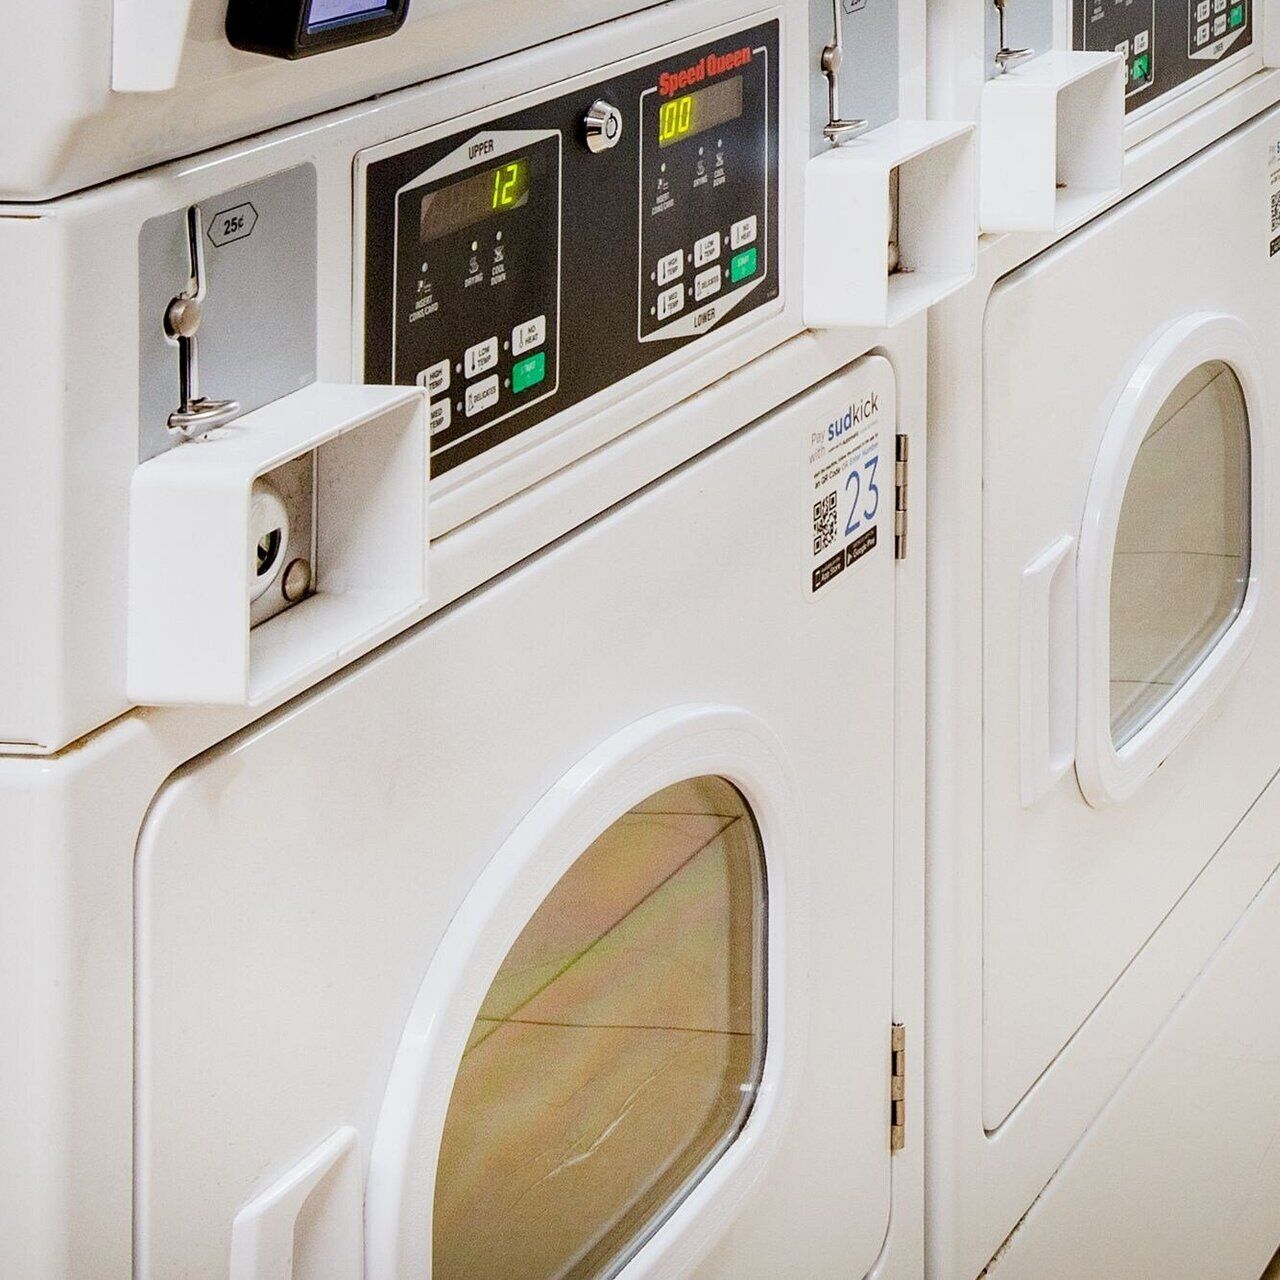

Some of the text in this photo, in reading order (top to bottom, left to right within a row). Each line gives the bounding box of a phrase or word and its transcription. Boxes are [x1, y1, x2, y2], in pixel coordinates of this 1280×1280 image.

[659, 46, 751, 96] Speed Queen
[468, 137, 494, 160] UPPER
[491, 162, 518, 210] 12
[223, 214, 244, 236] 25¢
[491, 262, 505, 276] COOL
[693, 306, 715, 329] LOWER
[527, 323, 535, 334] NO
[525, 332, 538, 346] HEAT
[477, 353, 491, 368] TEMP
[478, 344, 490, 358] LOW
[429, 367, 442, 381] HIGH
[429, 376, 443, 391] TEMP
[473, 384, 496, 404] DELICATES
[828, 391, 878, 441] sudkick
[844, 455, 879, 537] 23
